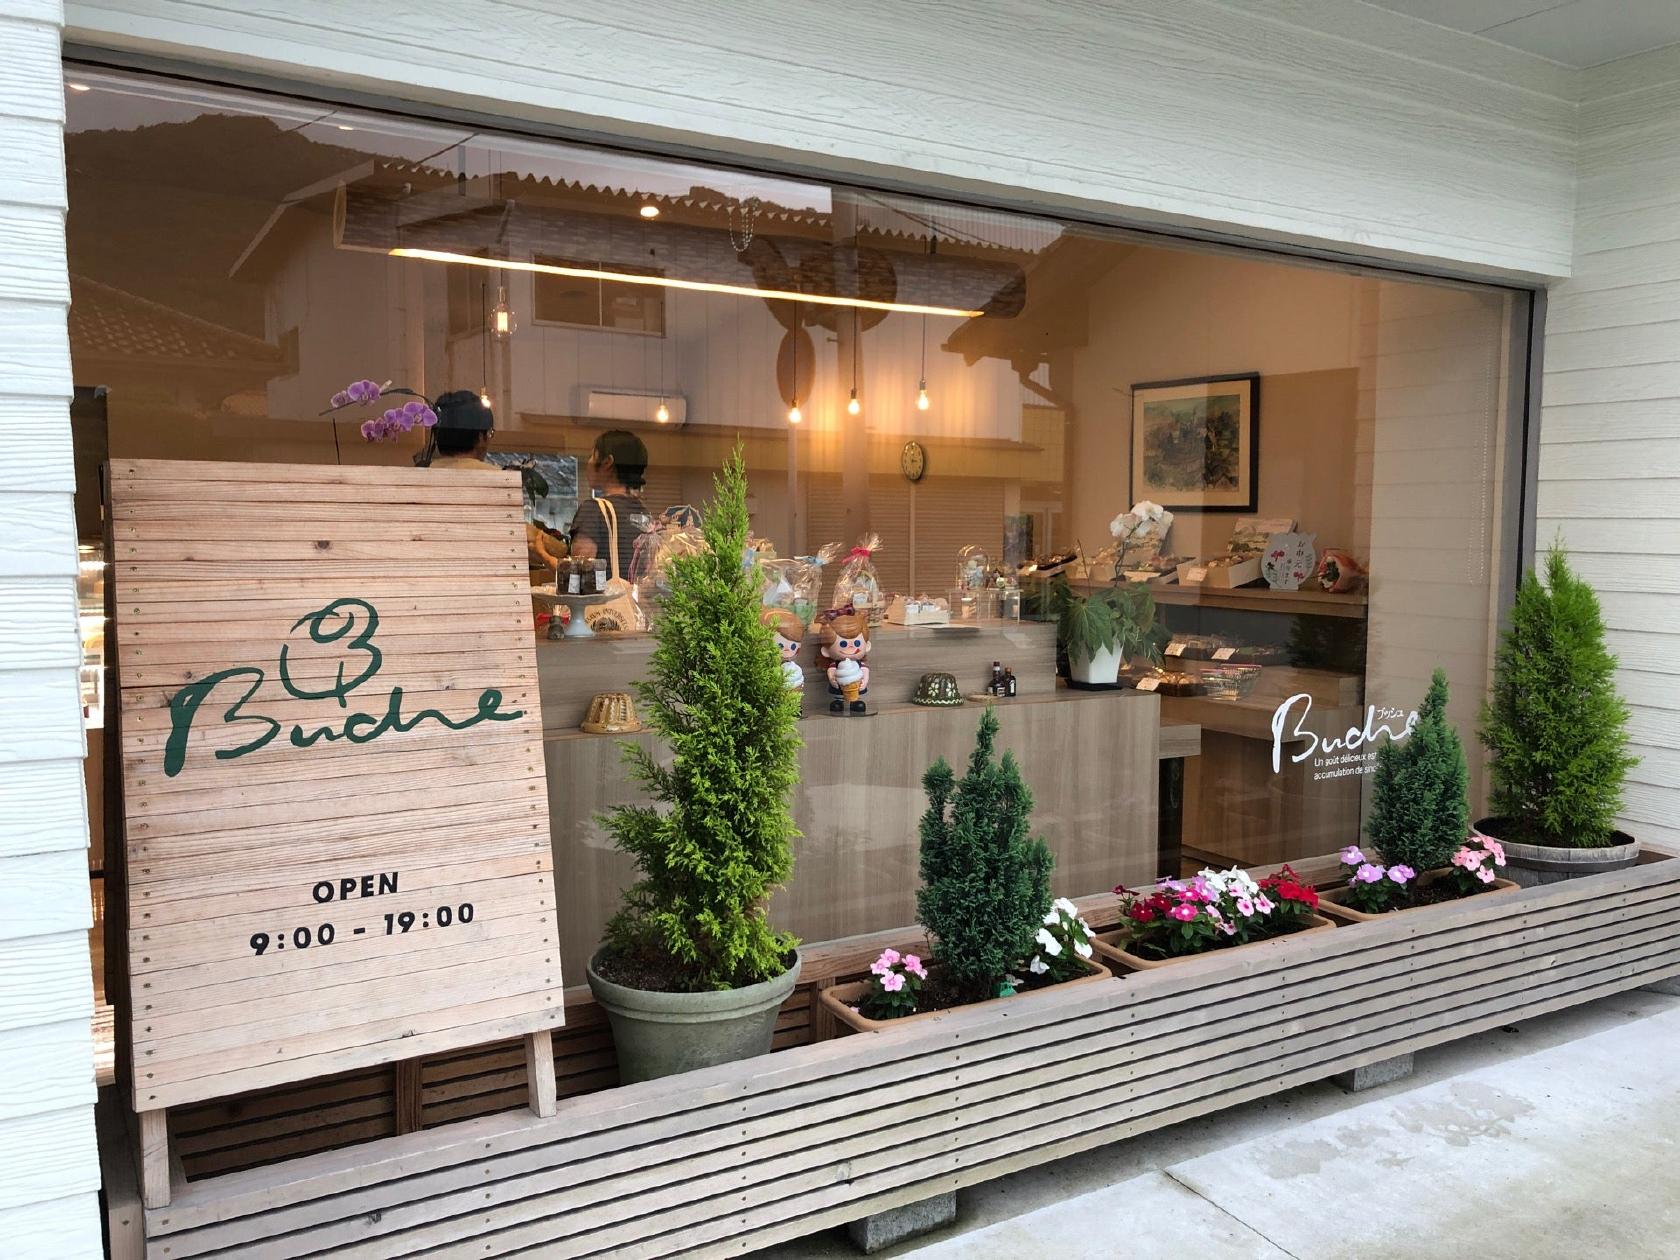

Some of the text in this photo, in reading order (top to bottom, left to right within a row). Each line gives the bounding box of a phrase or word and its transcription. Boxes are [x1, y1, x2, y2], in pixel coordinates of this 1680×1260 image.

[1314, 757, 1324, 767] Un
[1314, 767, 1354, 780] accumulation
[1355, 765, 1363, 774] de
[312, 871, 399, 903] OPEN
[250, 922, 336, 956] 9:00
[384, 902, 475, 936] 19:00
